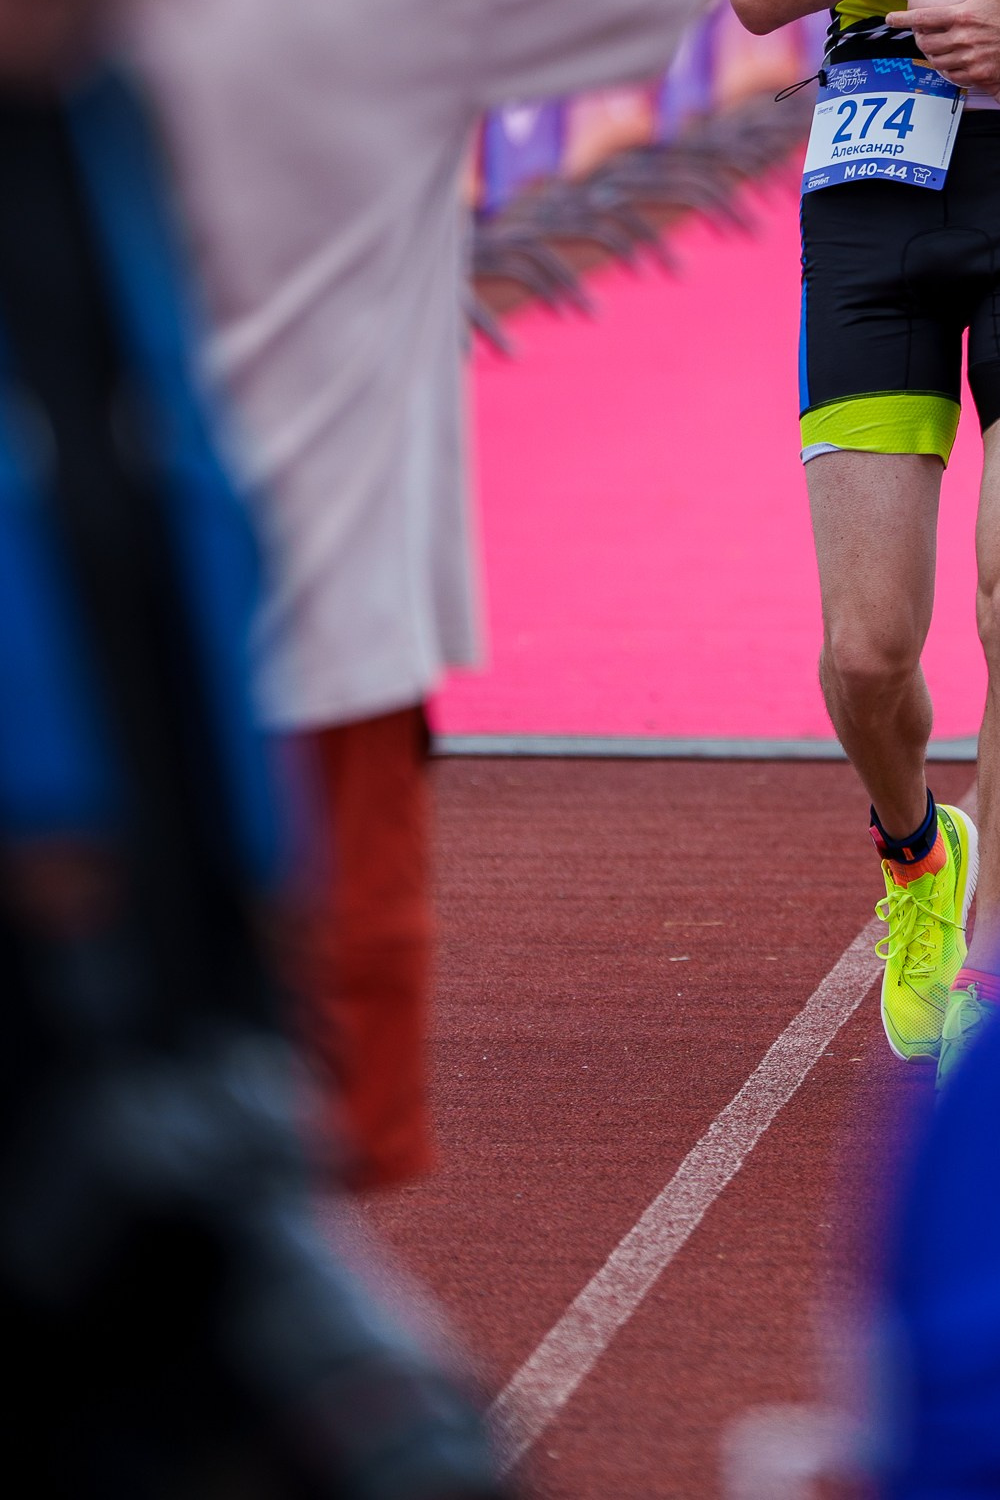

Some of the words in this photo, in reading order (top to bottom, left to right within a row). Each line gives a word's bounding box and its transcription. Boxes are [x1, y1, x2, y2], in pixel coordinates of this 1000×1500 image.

[831, 97, 916, 145] 274
[830, 143, 905, 160] Александр
[808, 176, 830, 189] СПРИНТ
